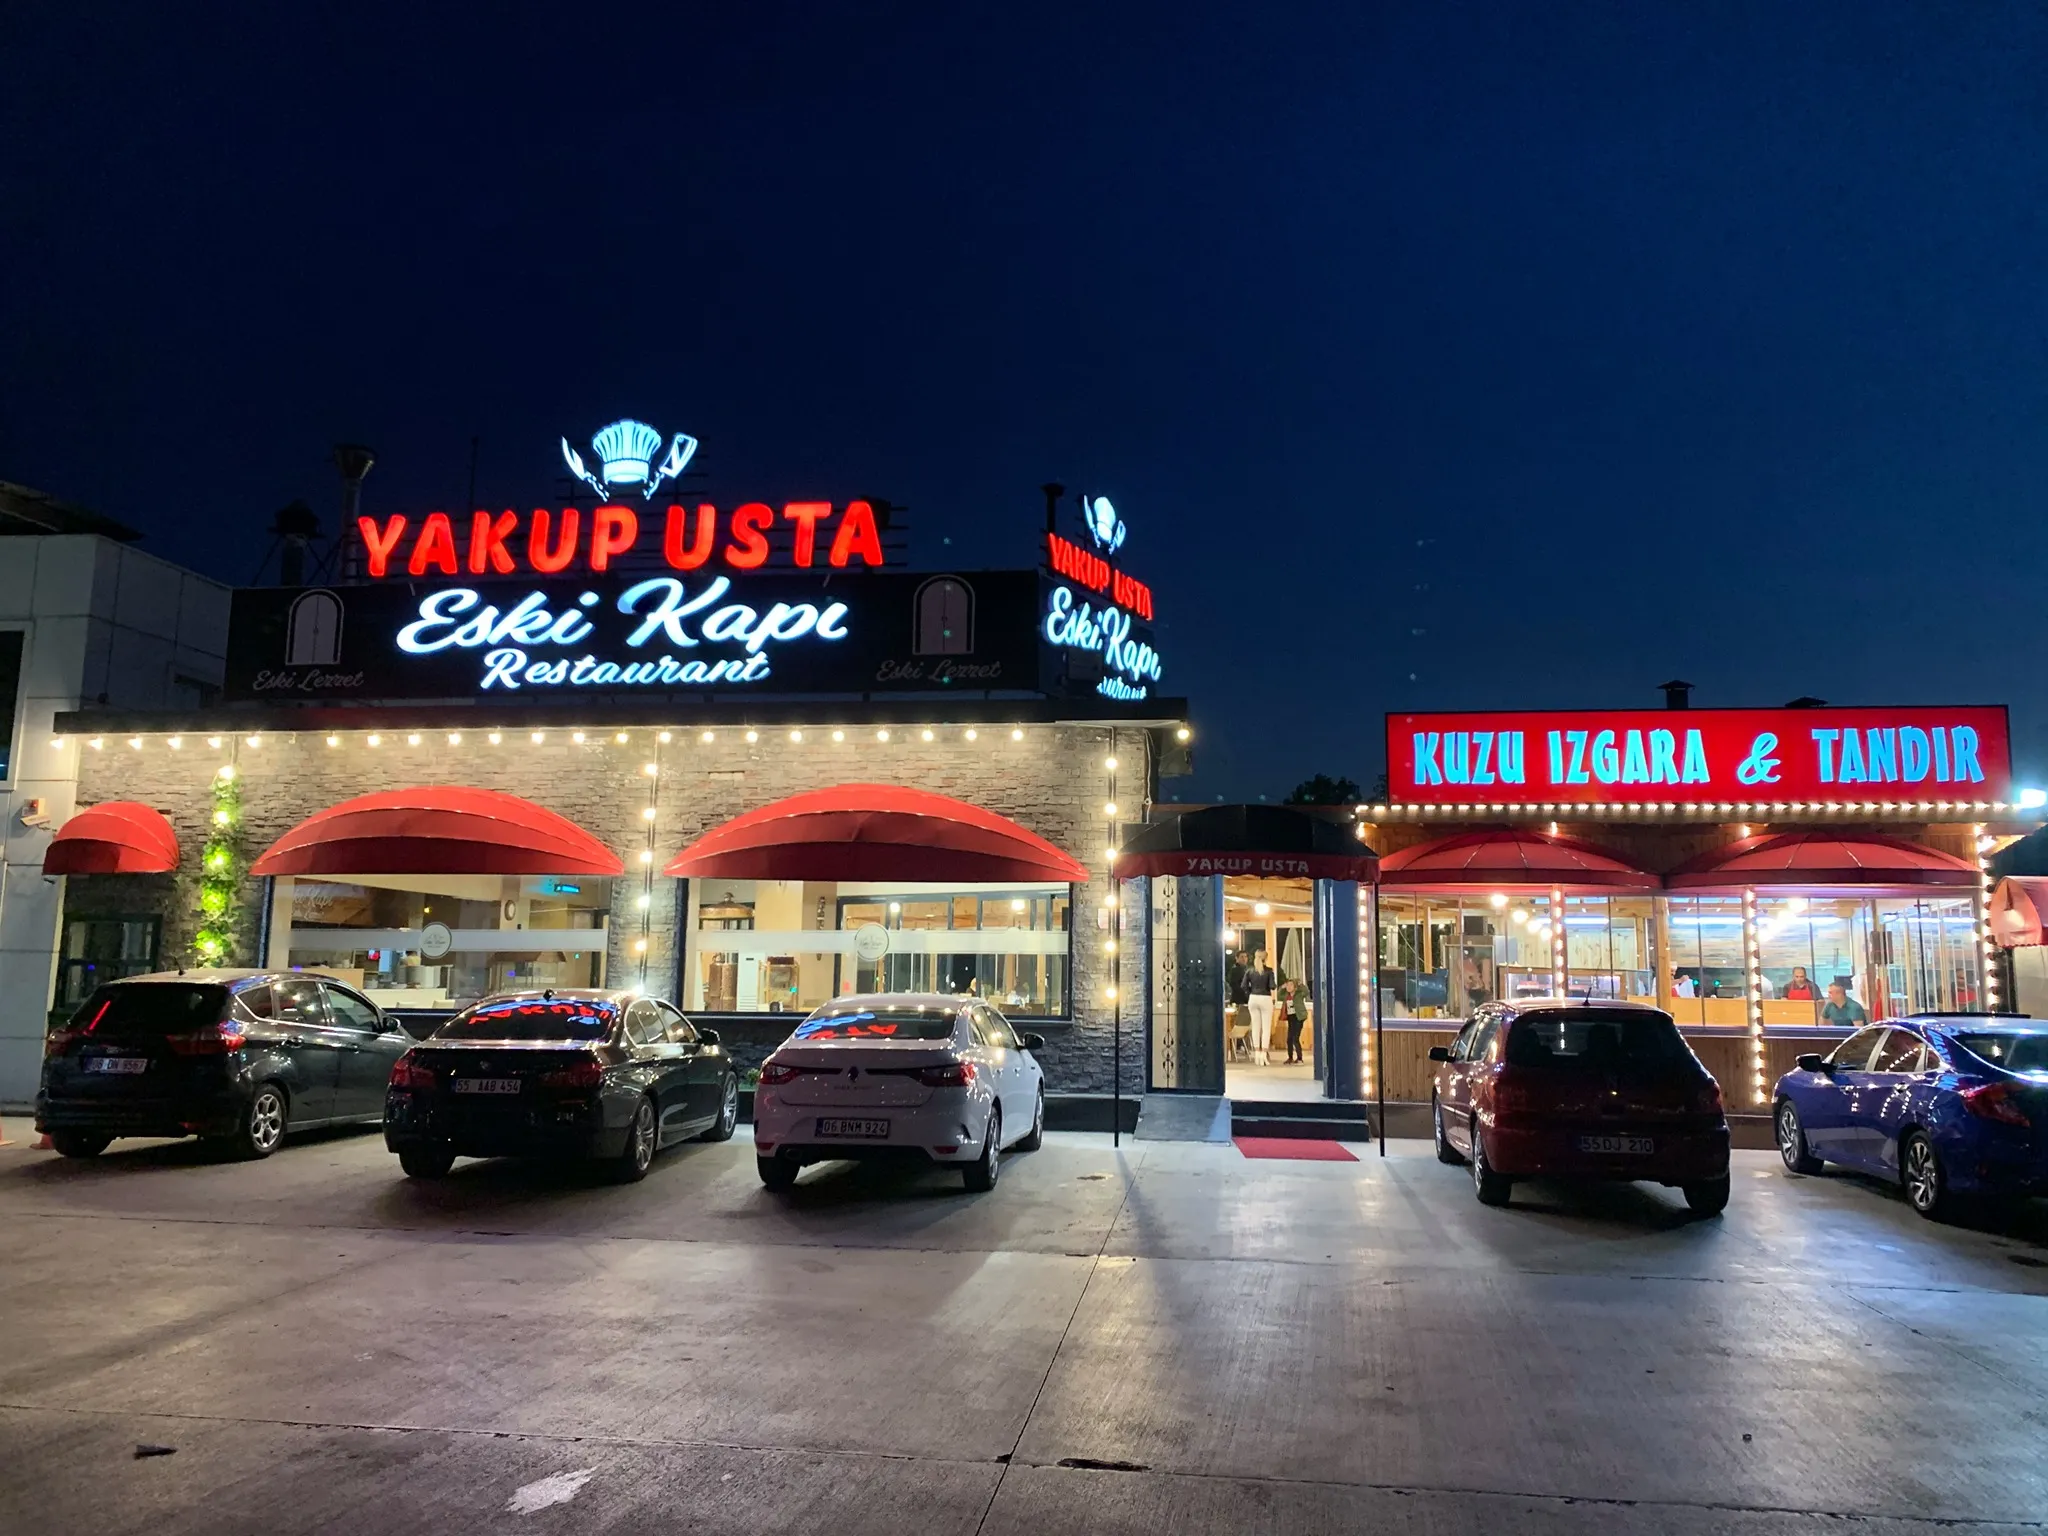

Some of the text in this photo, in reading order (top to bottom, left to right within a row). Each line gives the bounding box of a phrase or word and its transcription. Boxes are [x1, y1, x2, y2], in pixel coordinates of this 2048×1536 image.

[357, 500, 885, 577] YAKUP USTA
[1048, 532, 1154, 622] YAKUP USTA
[395, 586, 600, 656] Eski
[1046, 586, 1104, 650] Eski
[252, 668, 365, 691] Eski Lezzet
[480, 647, 772, 690] Restaurant
[876, 659, 1002, 682] Eski Lezzet
[1412, 724, 1985, 786] KUZU IZGARA & TANDIR
[1186, 858, 1310, 873] YAKUP USTA
[457, 1079, 471, 1092] 55
[823, 1120, 837, 1133] 06
[865, 1121, 885, 1134] 924
[1629, 1139, 1653, 1152] 210
